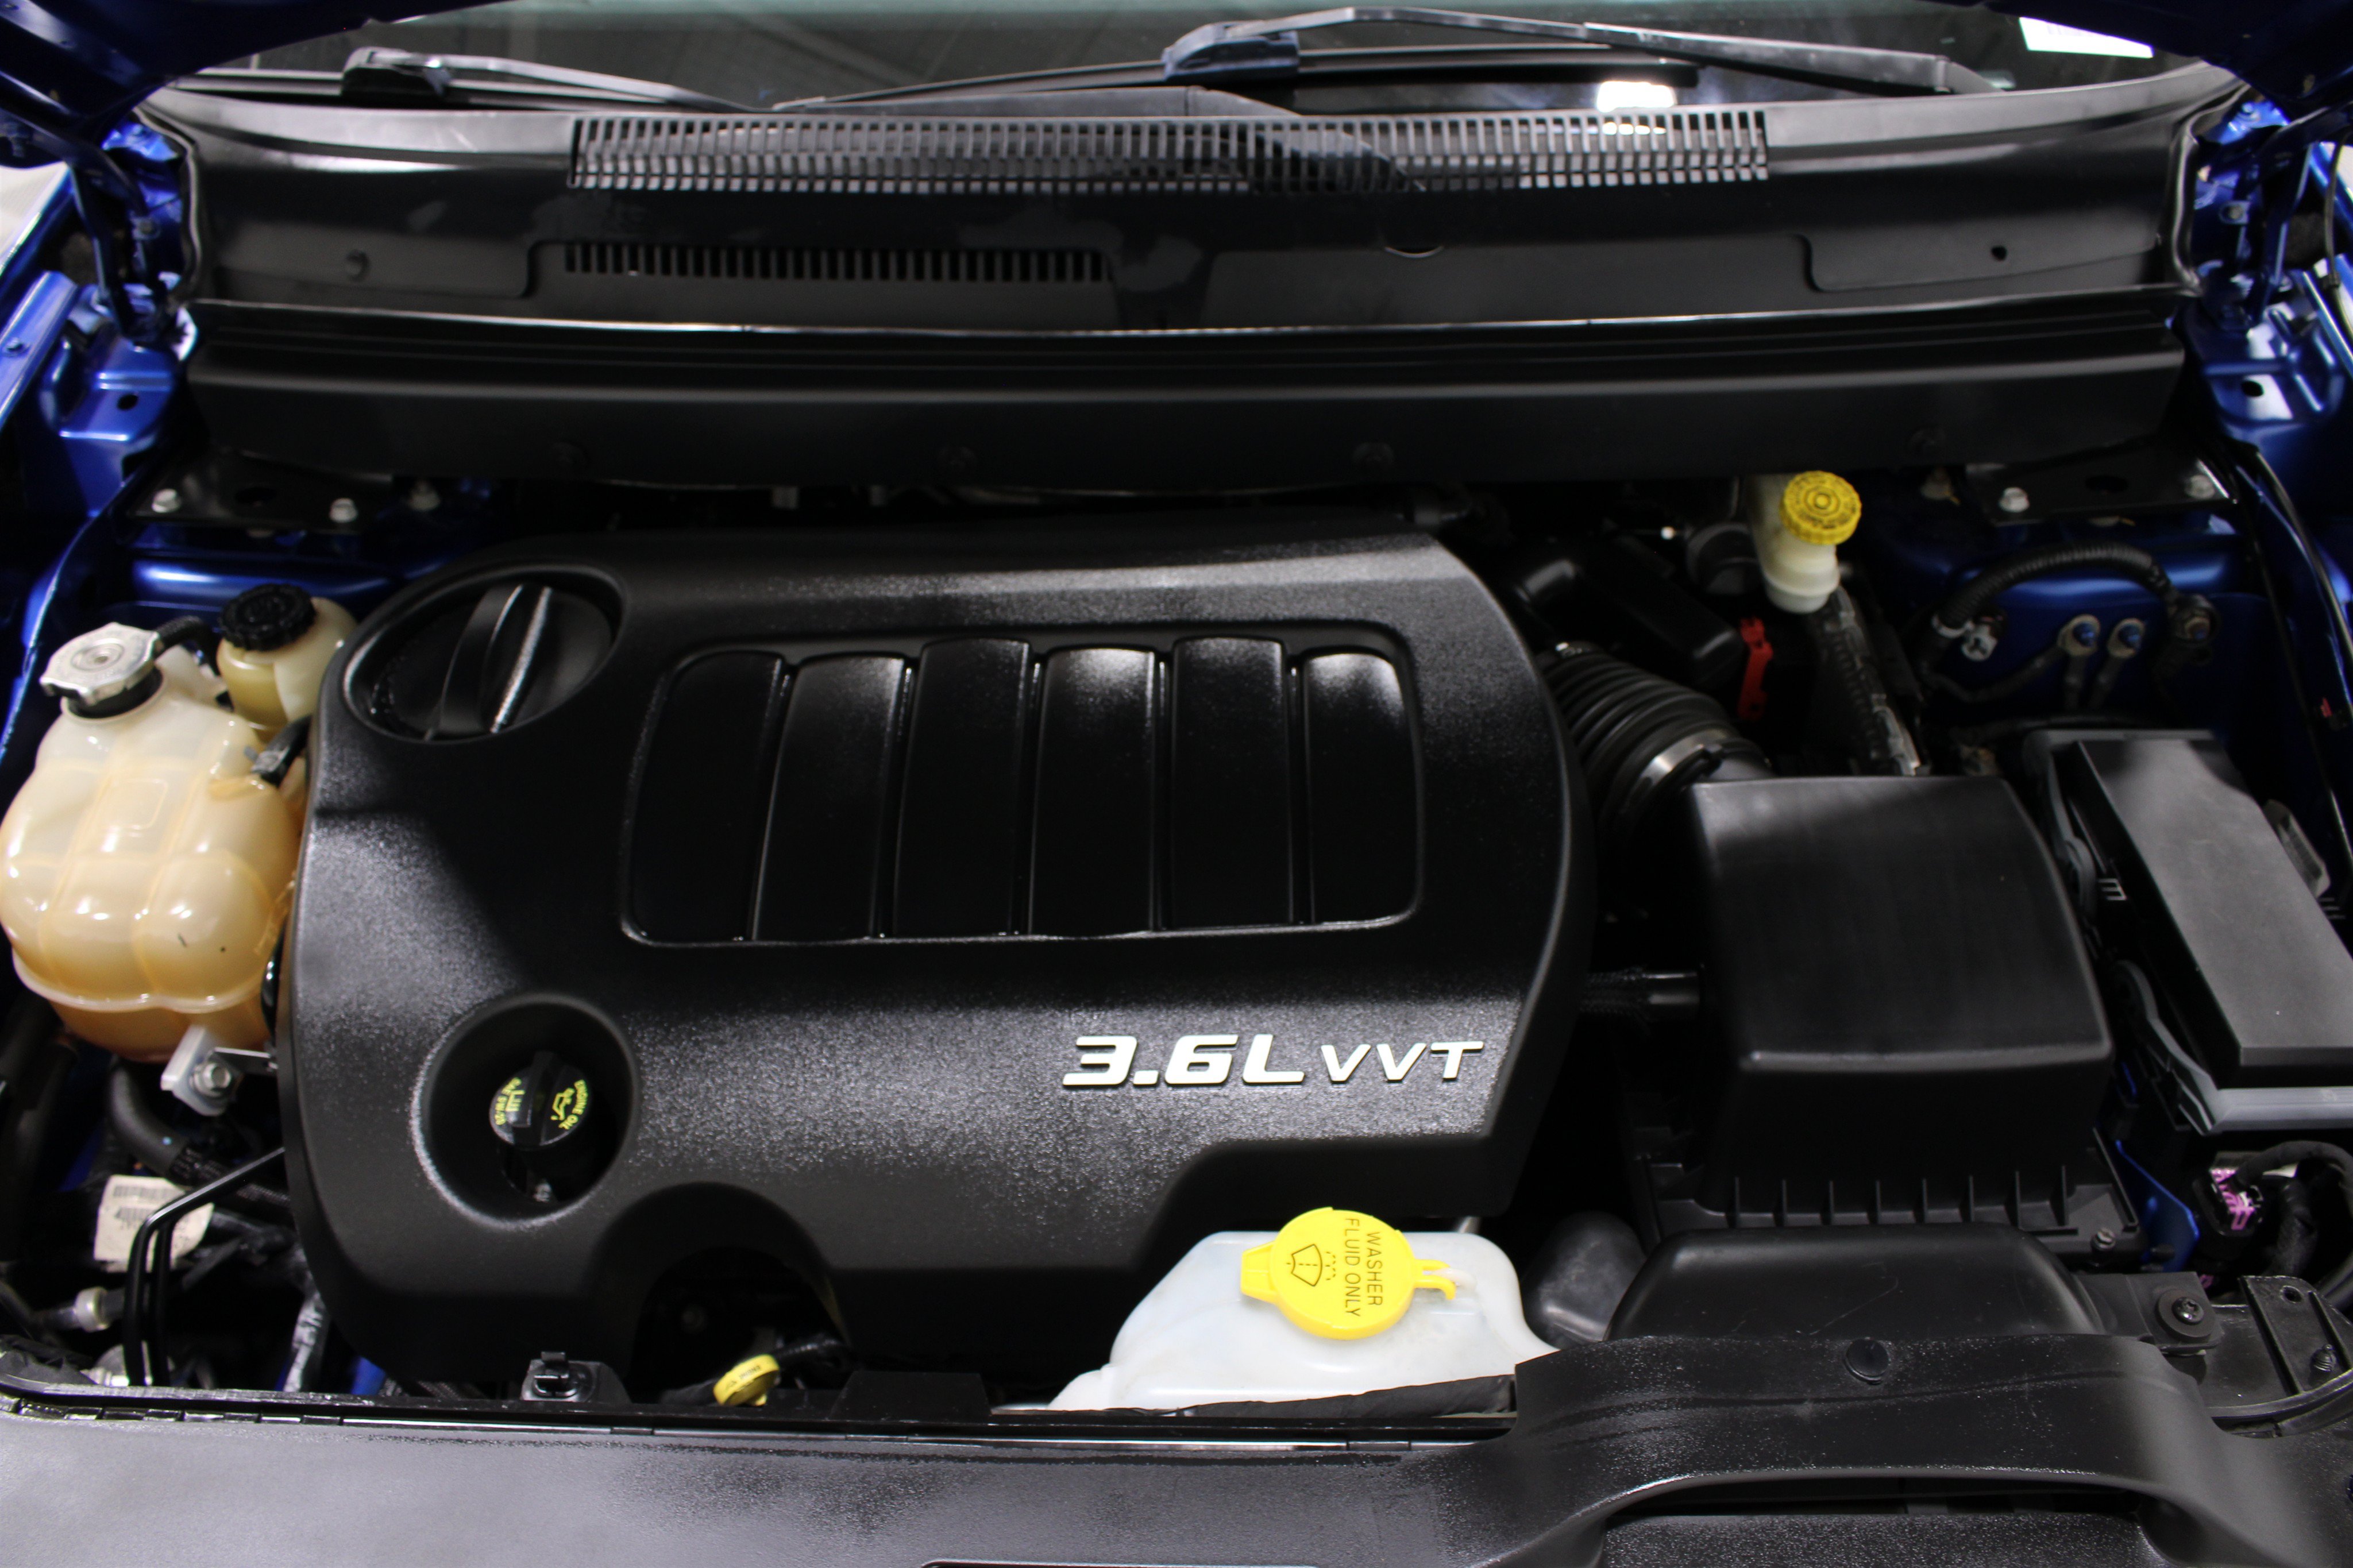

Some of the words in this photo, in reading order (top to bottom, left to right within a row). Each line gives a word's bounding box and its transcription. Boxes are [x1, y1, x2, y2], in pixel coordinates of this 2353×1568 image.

[1063, 1034, 1305, 1086] 3.6L
[1321, 1041, 1484, 1083] VVT
[573, 1079, 588, 1115] ENGINE
[558, 1114, 578, 1130] OIL
[1344, 1218, 1360, 1266] FLUID
[1367, 1231, 1383, 1306] WASHER
[1344, 1272, 1361, 1317] ONLY
